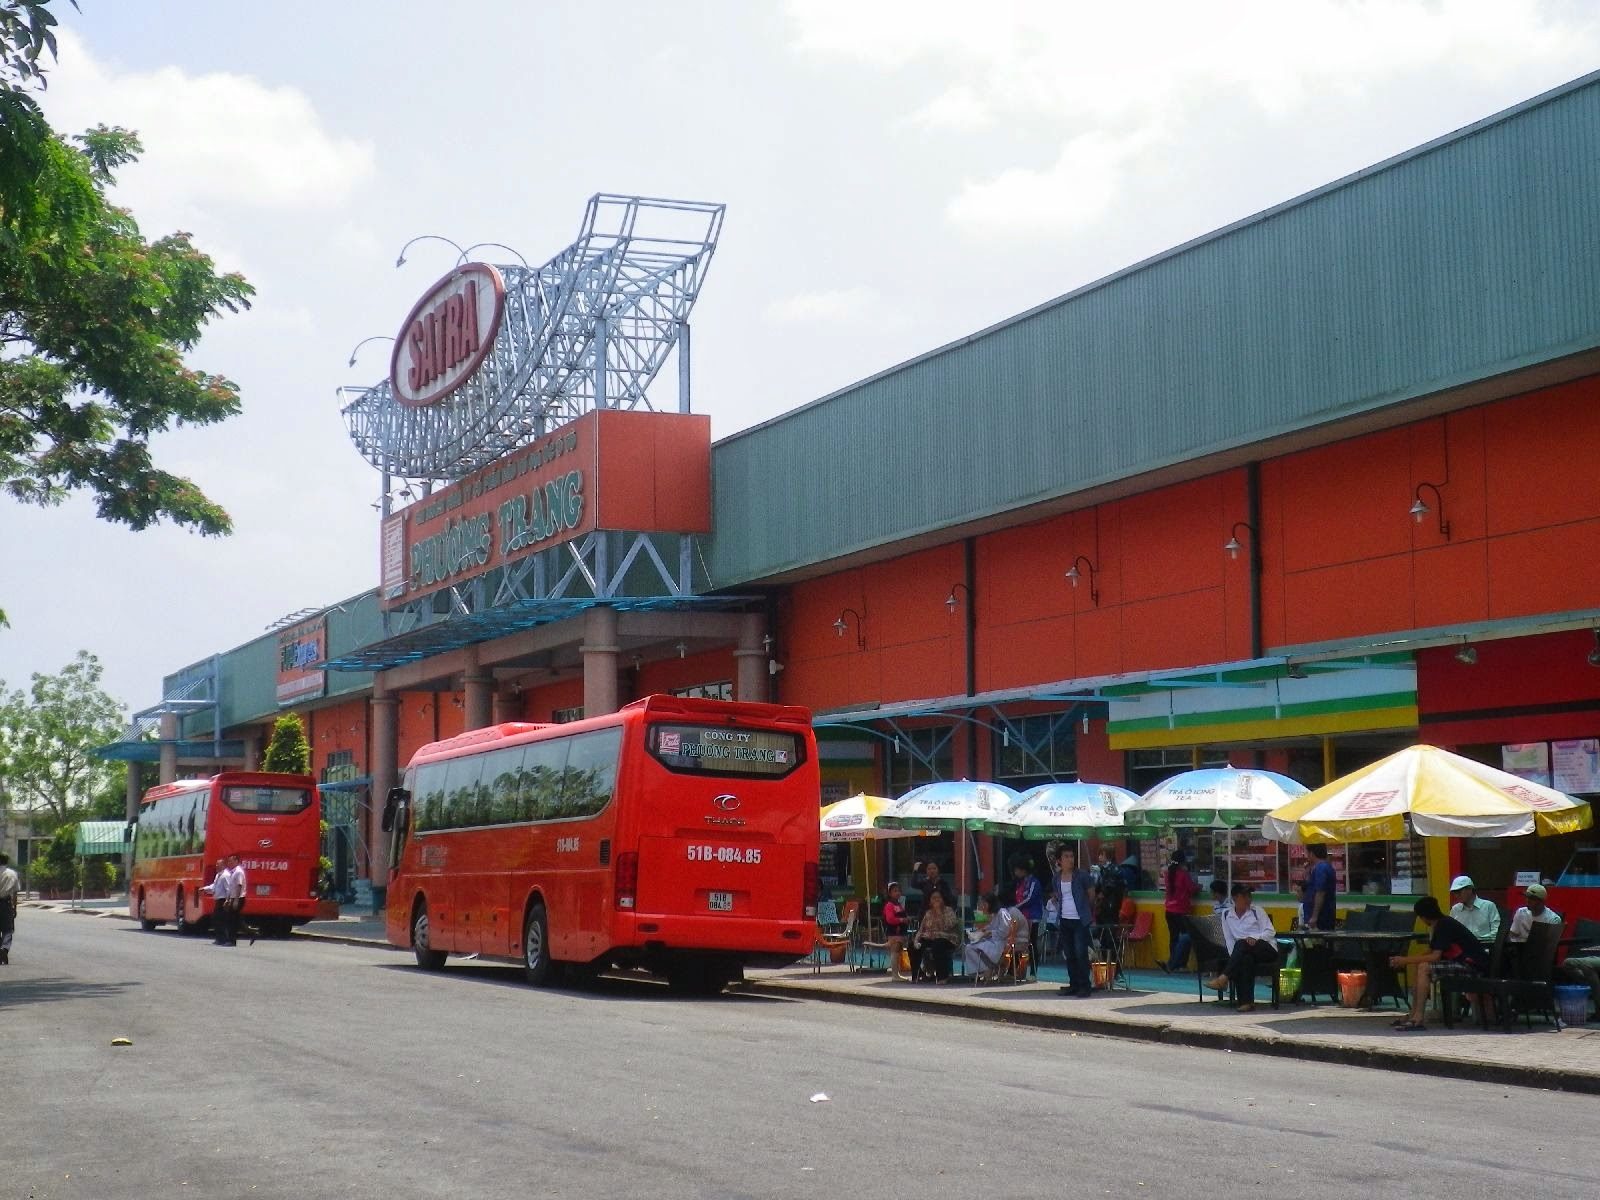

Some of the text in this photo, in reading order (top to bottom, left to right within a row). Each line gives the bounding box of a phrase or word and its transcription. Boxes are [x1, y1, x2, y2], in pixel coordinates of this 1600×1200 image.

[408, 279, 480, 391] SATRA
[497, 469, 583, 555] TRANG
[704, 728, 750, 743] CÔNG TY
[734, 747, 776, 762] TRANG
[687, 845, 761, 864] 51B-084.85
